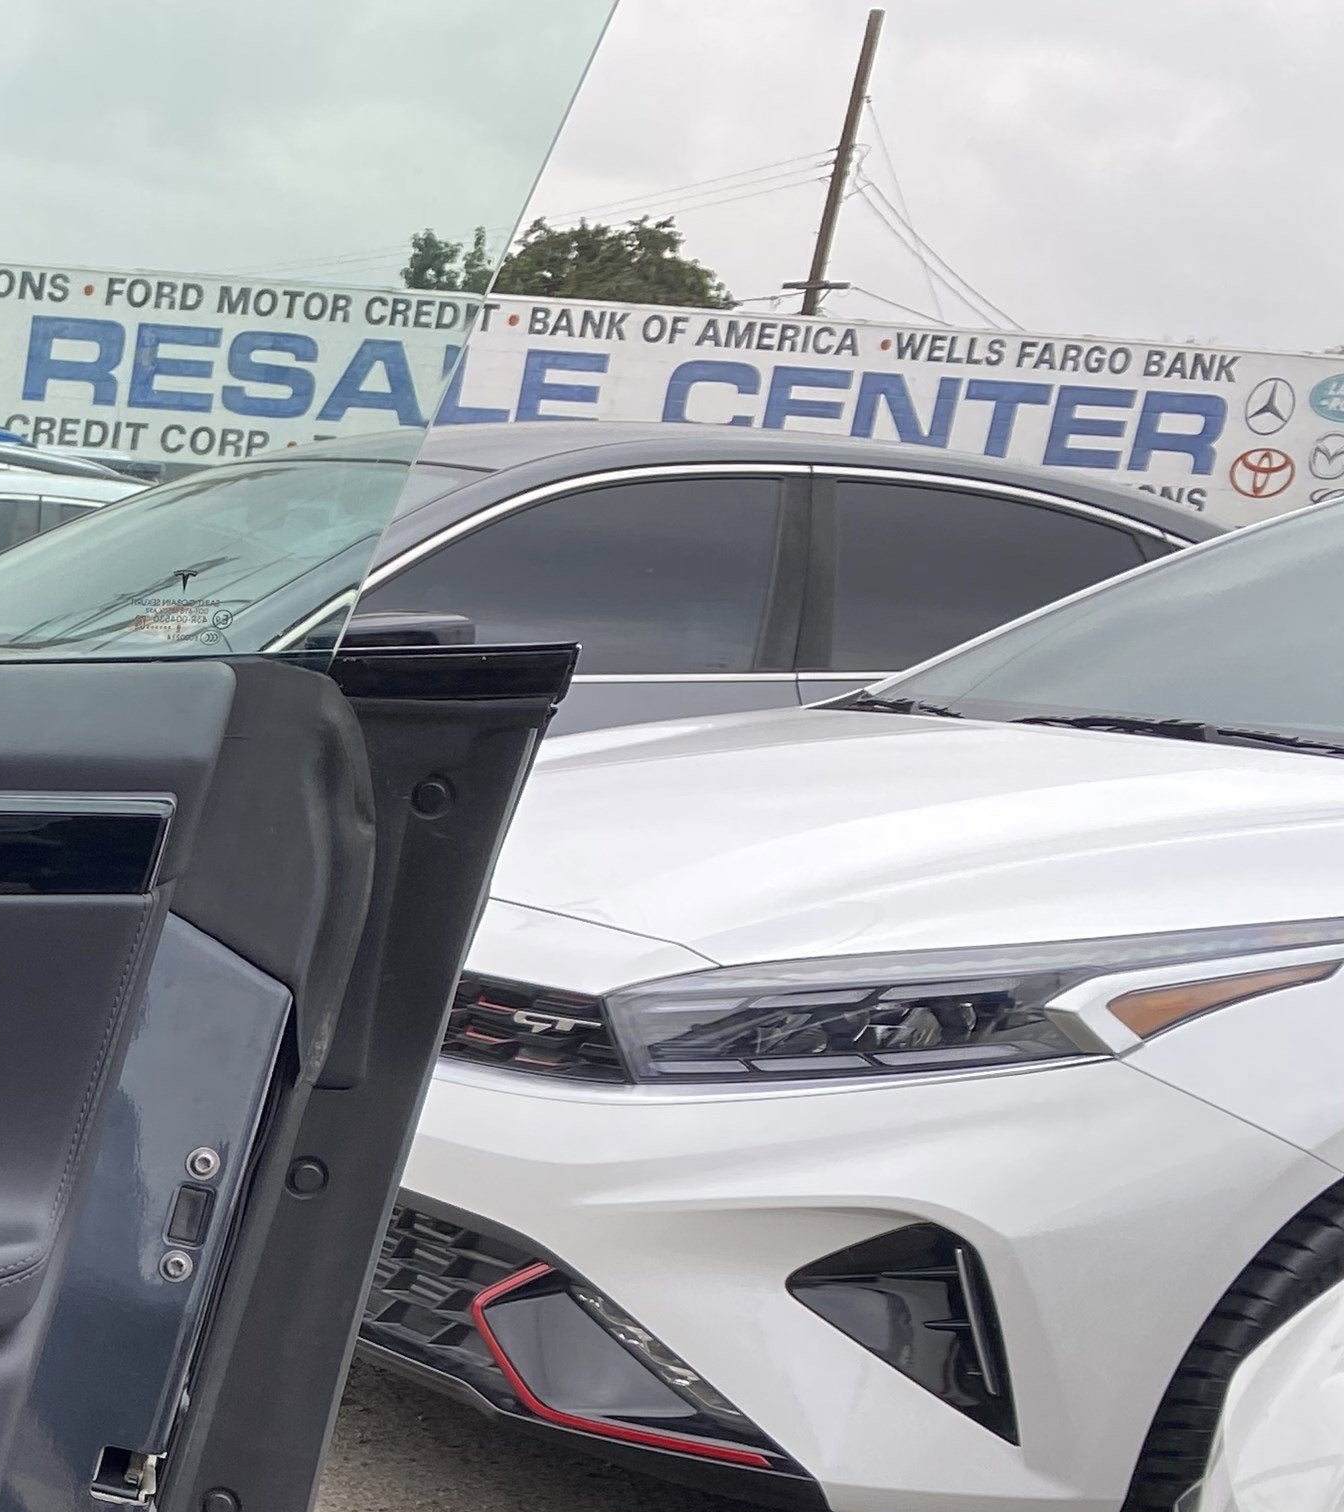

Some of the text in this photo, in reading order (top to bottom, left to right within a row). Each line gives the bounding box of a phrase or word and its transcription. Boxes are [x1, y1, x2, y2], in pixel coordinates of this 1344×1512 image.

[105, 276, 205, 312] FORD
[216, 285, 351, 325] MOTOR
[364, 296, 502, 333] CREDIT
[526, 305, 632, 342] BANK
[641, 314, 691, 345] OF
[695, 318, 860, 357] AMERICA
[895, 330, 1008, 368] WELLS
[1015, 340, 1133, 376] FARGO
[1142, 348, 1242, 384] BANK
[4, 412, 149, 451] CREDIT
[21, 314, 611, 427] RESALE
[662, 358, 1229, 476] CENTER
